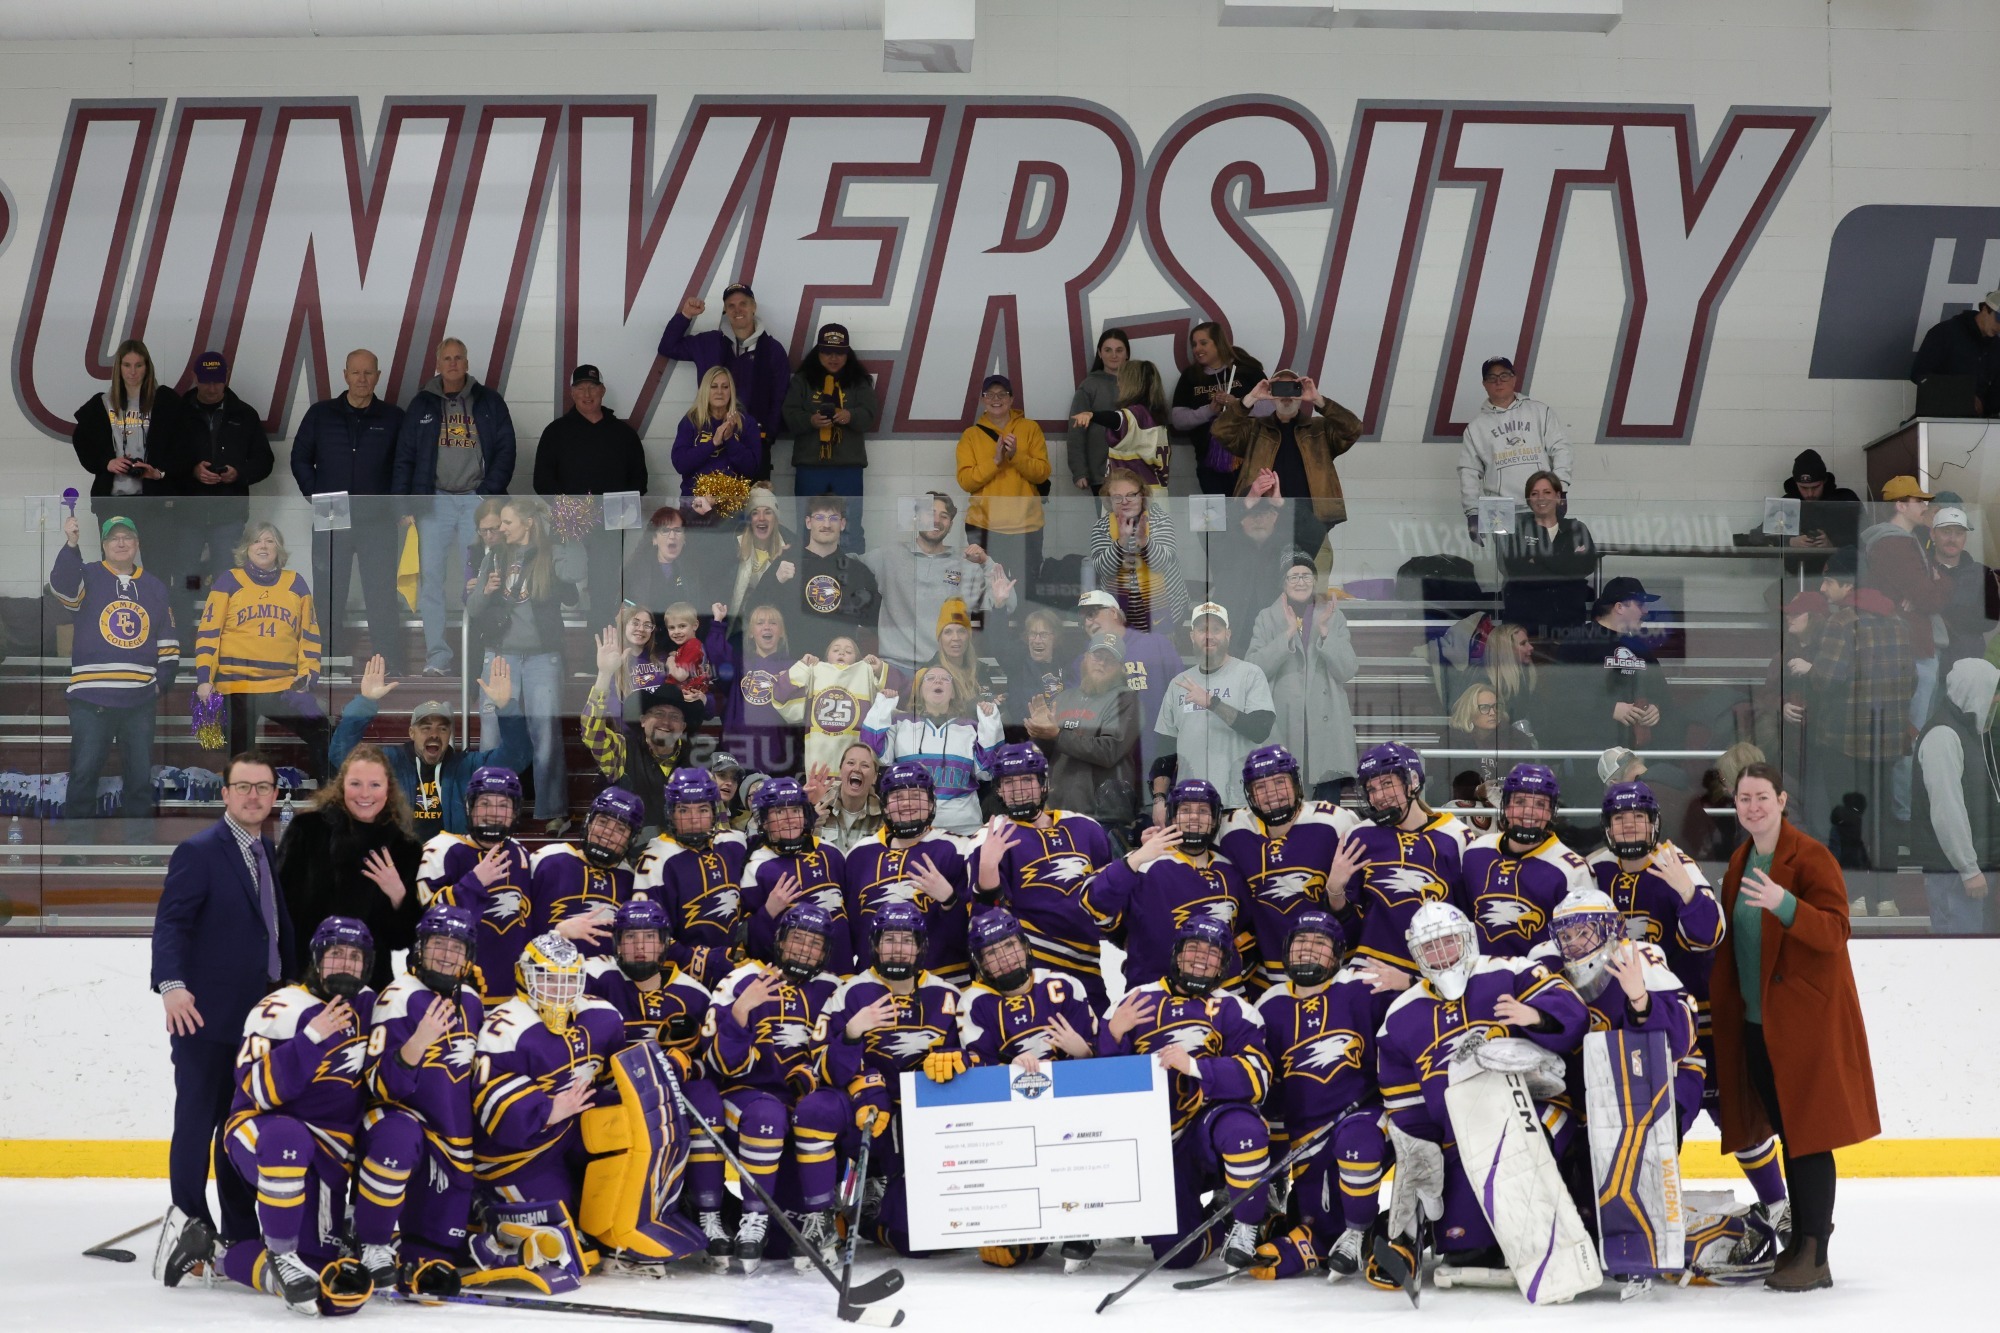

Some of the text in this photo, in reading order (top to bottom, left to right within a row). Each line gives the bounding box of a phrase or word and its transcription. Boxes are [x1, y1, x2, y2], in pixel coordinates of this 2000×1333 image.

[11, 93, 1830, 444] UNIVERSITY
[1491, 420, 1531, 438] ELMIRA
[440, 438, 477, 449] OCKEY
[1495, 454, 1539, 466] HOCKEY CLUB
[106, 601, 146, 619] ELMIRA
[814, 602, 835, 611] HOCKEY
[236, 604, 298, 633] ELMIRA
[257, 622, 276, 637] 14
[106, 633, 144, 648] COLLEGE
[1606, 658, 1646, 668] AUGGIES
[818, 697, 852, 722] 25
[821, 719, 846, 727] SEASONS
[1254, 760, 1274, 768] CCM
[1616, 793, 1636, 801] CCM
[612, 800, 632, 811] CCM
[414, 811, 442, 819] OCKEY
[803, 914, 823, 923] CCM
[339, 927, 360, 935] CCM
[984, 924, 1003, 935] CCM
[1198, 923, 1219, 933] CCM
[1047, 980, 1066, 1004] C
[941, 991, 956, 1015] A
[654, 1050, 687, 1116] VAUGHN
[1505, 1073, 1538, 1133] CCM
[1077, 1131, 1102, 1139] AMHERST
[1660, 1158, 1681, 1224] VAUGHN
[497, 1210, 549, 1225] VAUGHN
